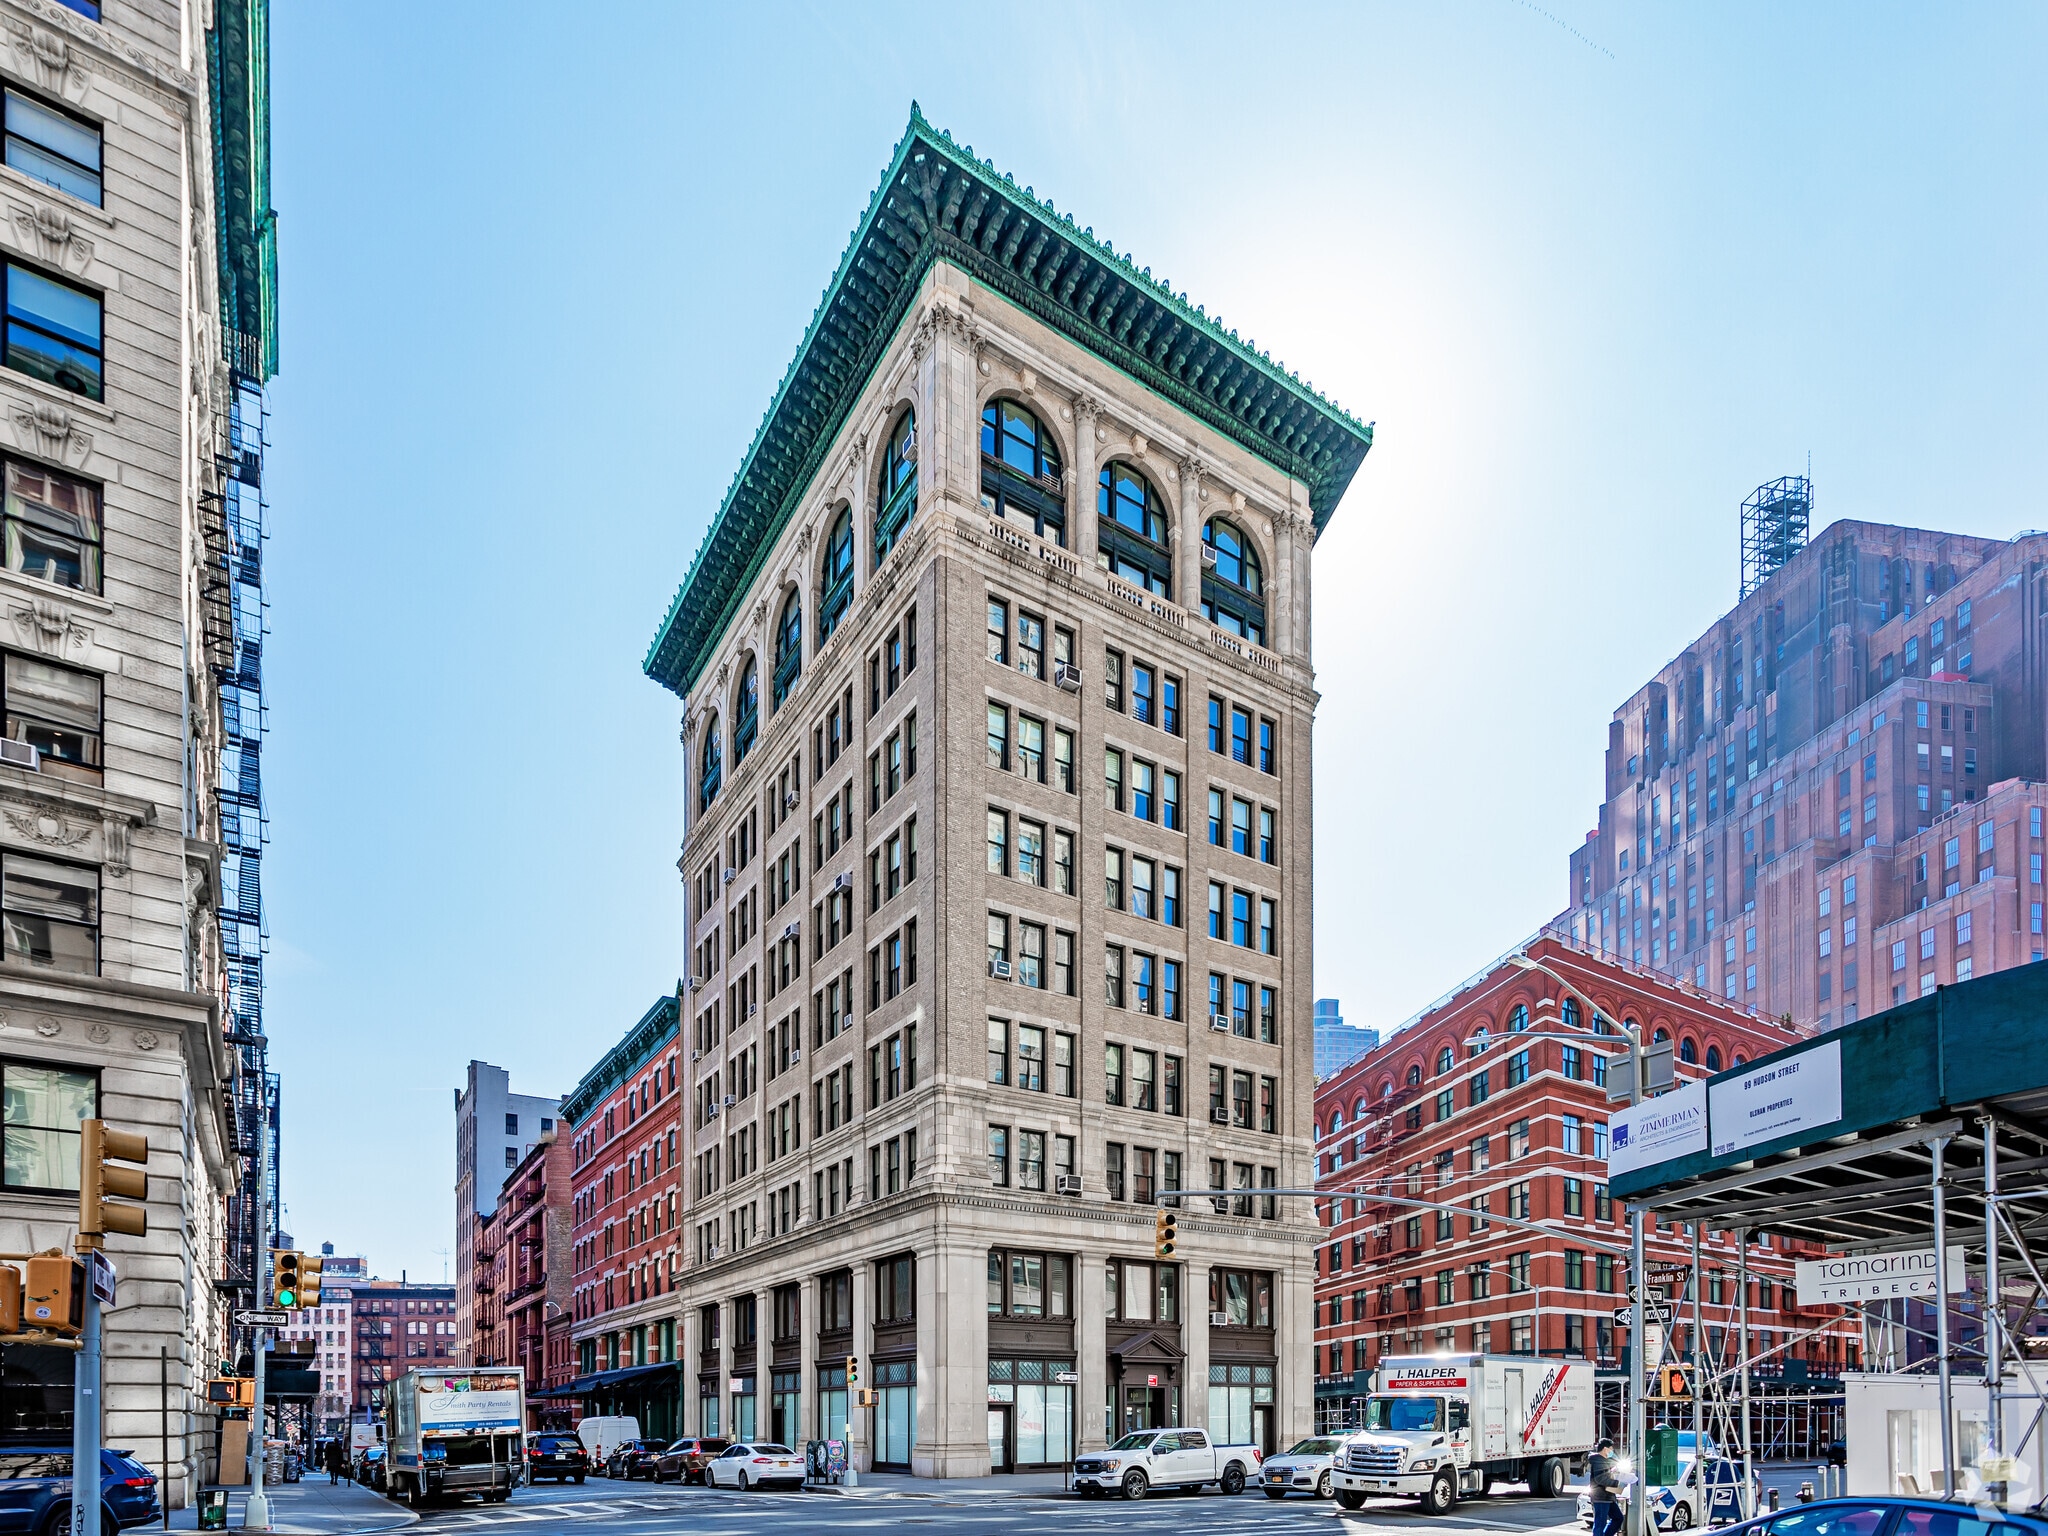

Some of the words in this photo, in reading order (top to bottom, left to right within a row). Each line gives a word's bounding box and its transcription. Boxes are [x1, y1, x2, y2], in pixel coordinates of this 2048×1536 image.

[1744, 1080, 1752, 1090] 99
[1753, 1071, 1776, 1087] HUDSON
[1778, 1063, 1800, 1078] STREET
[1767, 1097, 1793, 1112] PROPERTIES
[1639, 1106, 1700, 1135] ZIMMERMAN
[1640, 1131, 1664, 1142] ARCHITECTS
[1648, 1273, 1674, 1284] Franklin
[1676, 1271, 1684, 1281] St
[1822, 1280, 1937, 1299] TRIBECA
[240, 1314, 257, 1322] ONE
[1397, 1370, 1404, 1379] I.
[1407, 1368, 1457, 1379] HALPER
[226, 1385, 234, 1399] 4
[1530, 1368, 1555, 1415] HALPER
[467, 1401, 486, 1409] Party
[487, 1400, 512, 1408] Rentals
